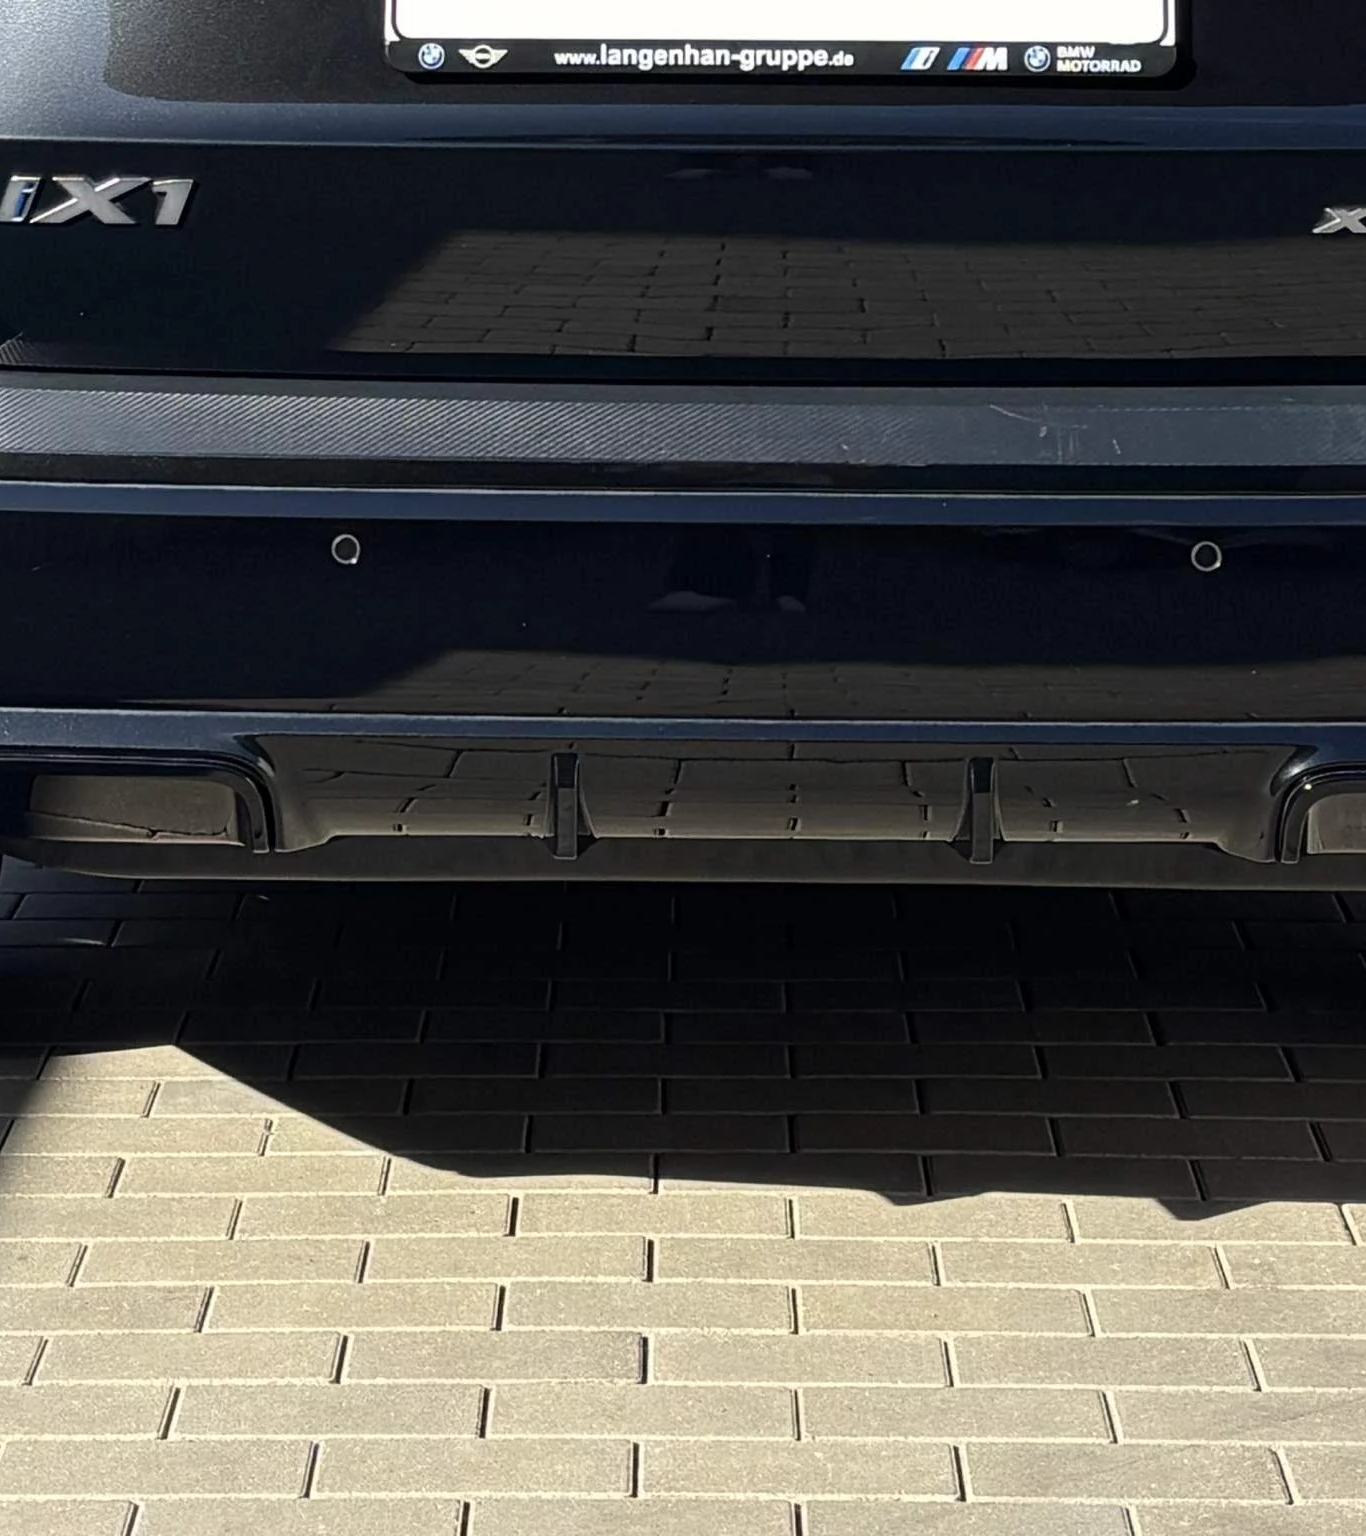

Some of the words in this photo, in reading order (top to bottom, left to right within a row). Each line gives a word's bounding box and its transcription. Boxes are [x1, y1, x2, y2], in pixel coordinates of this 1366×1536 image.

[554, 43, 854, 71] www.langenhan-gruppe.de
[1057, 46, 1095, 59] BMW
[1057, 59, 1142, 73] MOTORRAD
